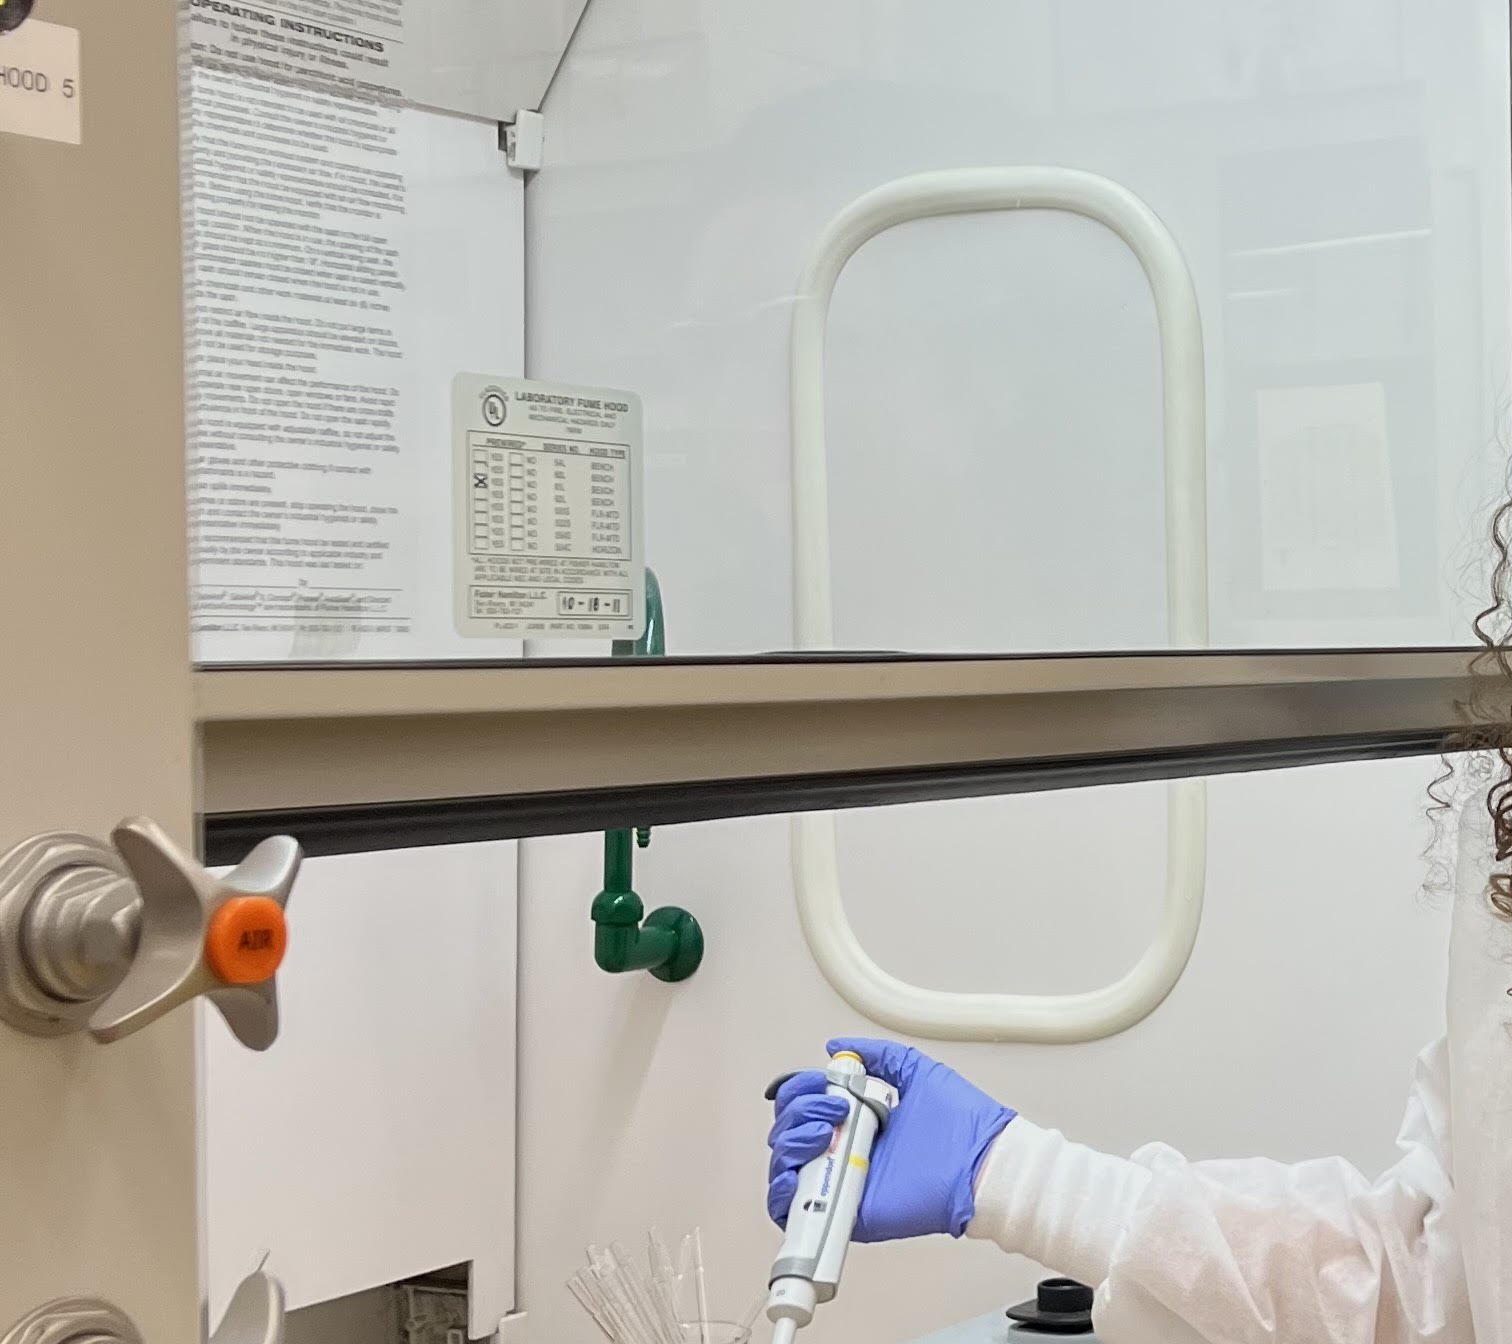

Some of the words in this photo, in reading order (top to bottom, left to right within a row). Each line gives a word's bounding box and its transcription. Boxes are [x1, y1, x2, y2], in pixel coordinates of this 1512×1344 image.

[280, 18, 385, 53] INSTRUCTIONS
[62, 78, 74, 98] 5
[515, 392, 574, 406] LABORATORY
[577, 399, 601, 409] FUME
[604, 402, 628, 412] HOOD
[238, 926, 274, 953] AIR
